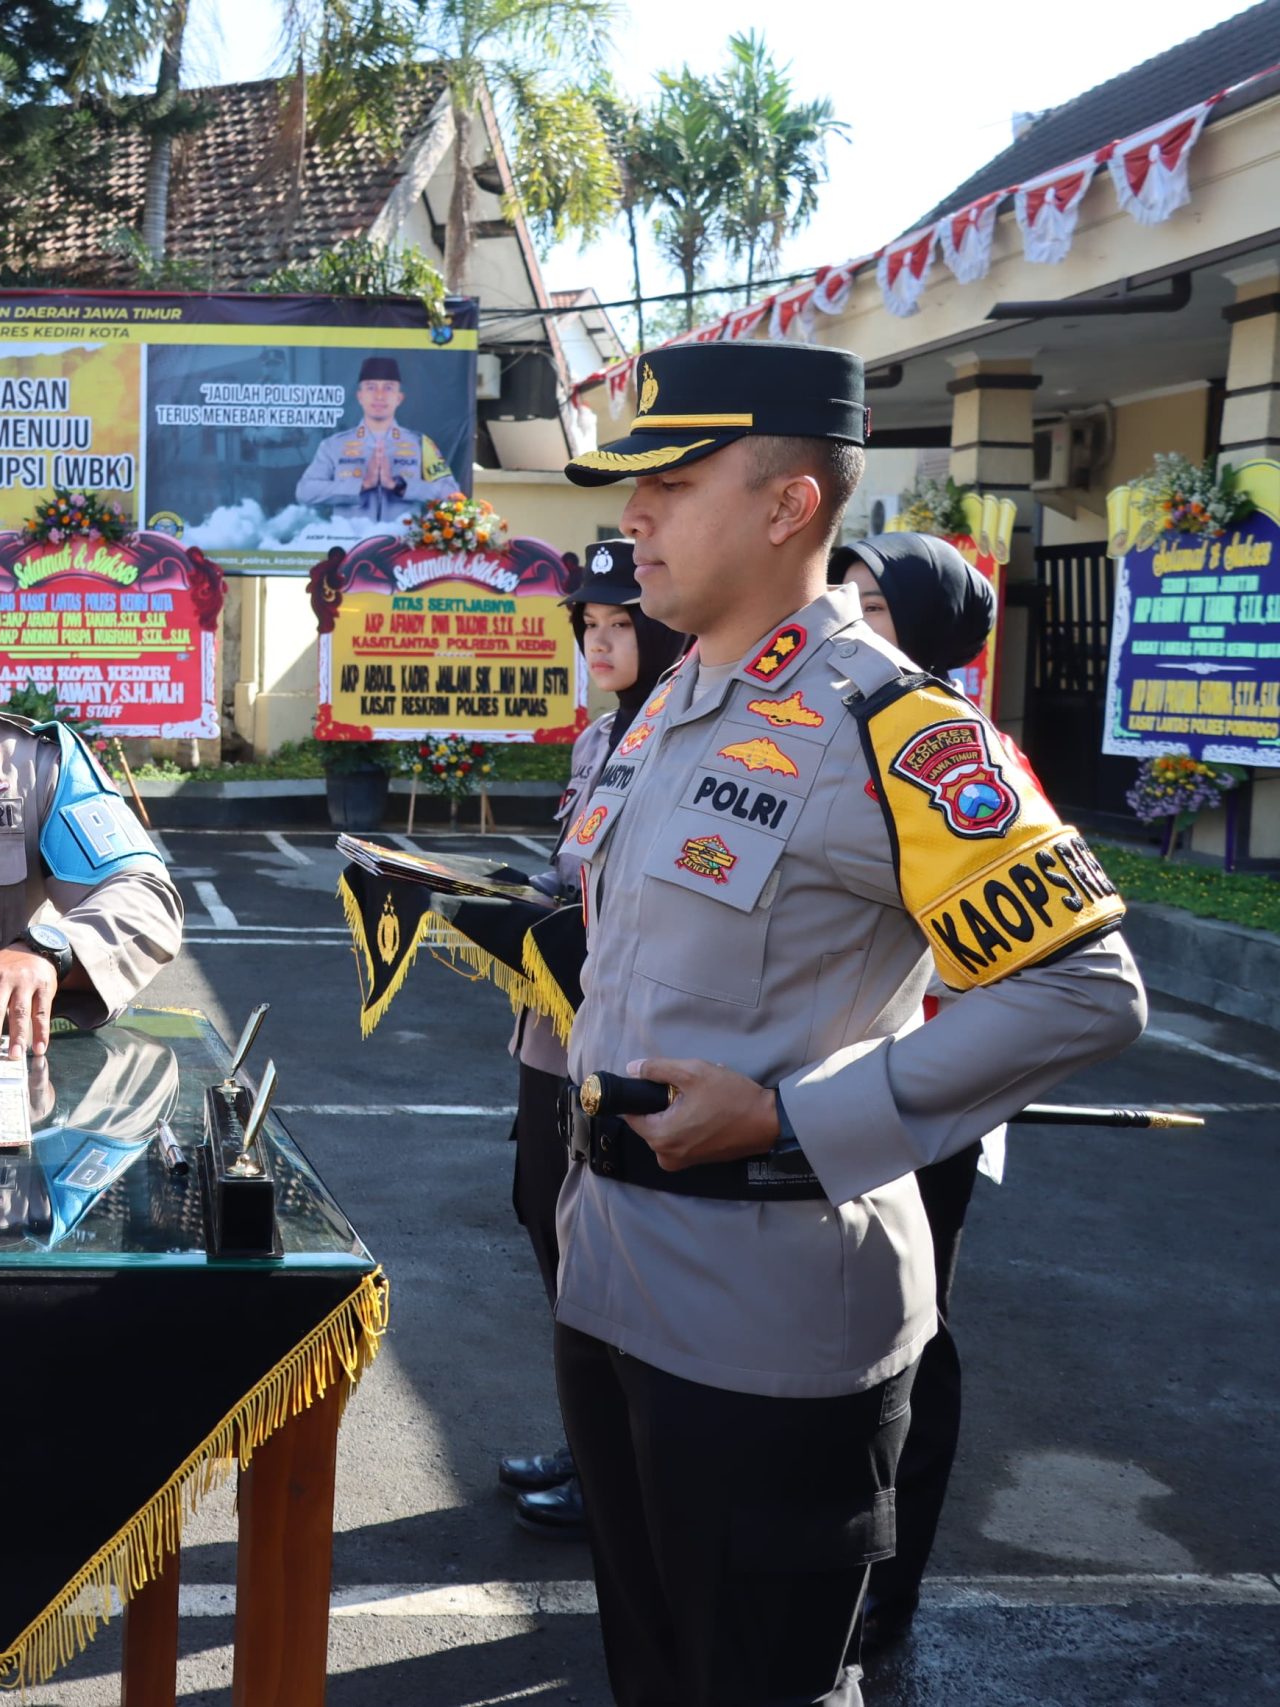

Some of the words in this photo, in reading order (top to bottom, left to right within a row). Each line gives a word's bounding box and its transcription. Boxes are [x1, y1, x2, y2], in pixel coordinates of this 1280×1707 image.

[14, 307, 80, 320] DAERAH
[82, 307, 128, 320] JAWA
[132, 308, 182, 321] TIMUR
[34, 327, 85, 338] KEDIRI
[89, 327, 130, 339] KOTA
[264, 385, 306, 404] POLISI
[307, 386, 344, 405] YANG
[157, 406, 199, 424] TERUS
[202, 407, 266, 425] MENEBAR
[53, 455, 134, 489] (WBK)
[391, 596, 424, 612] ATAS
[352, 636, 440, 650] KASATLANTAS
[447, 638, 510, 651] POLRESTA
[516, 640, 557, 652] KEDIRI
[107, 666, 170, 682] KEDIRI
[86, 704, 124, 718] STAFF
[907, 728, 972, 765] POLRES
[911, 742, 944, 771] KEDIRI
[945, 735, 974, 747] KOTA
[929, 758, 953, 780] JAWA
[951, 751, 979, 765] TIMUR
[692, 776, 788, 830] POLRI
